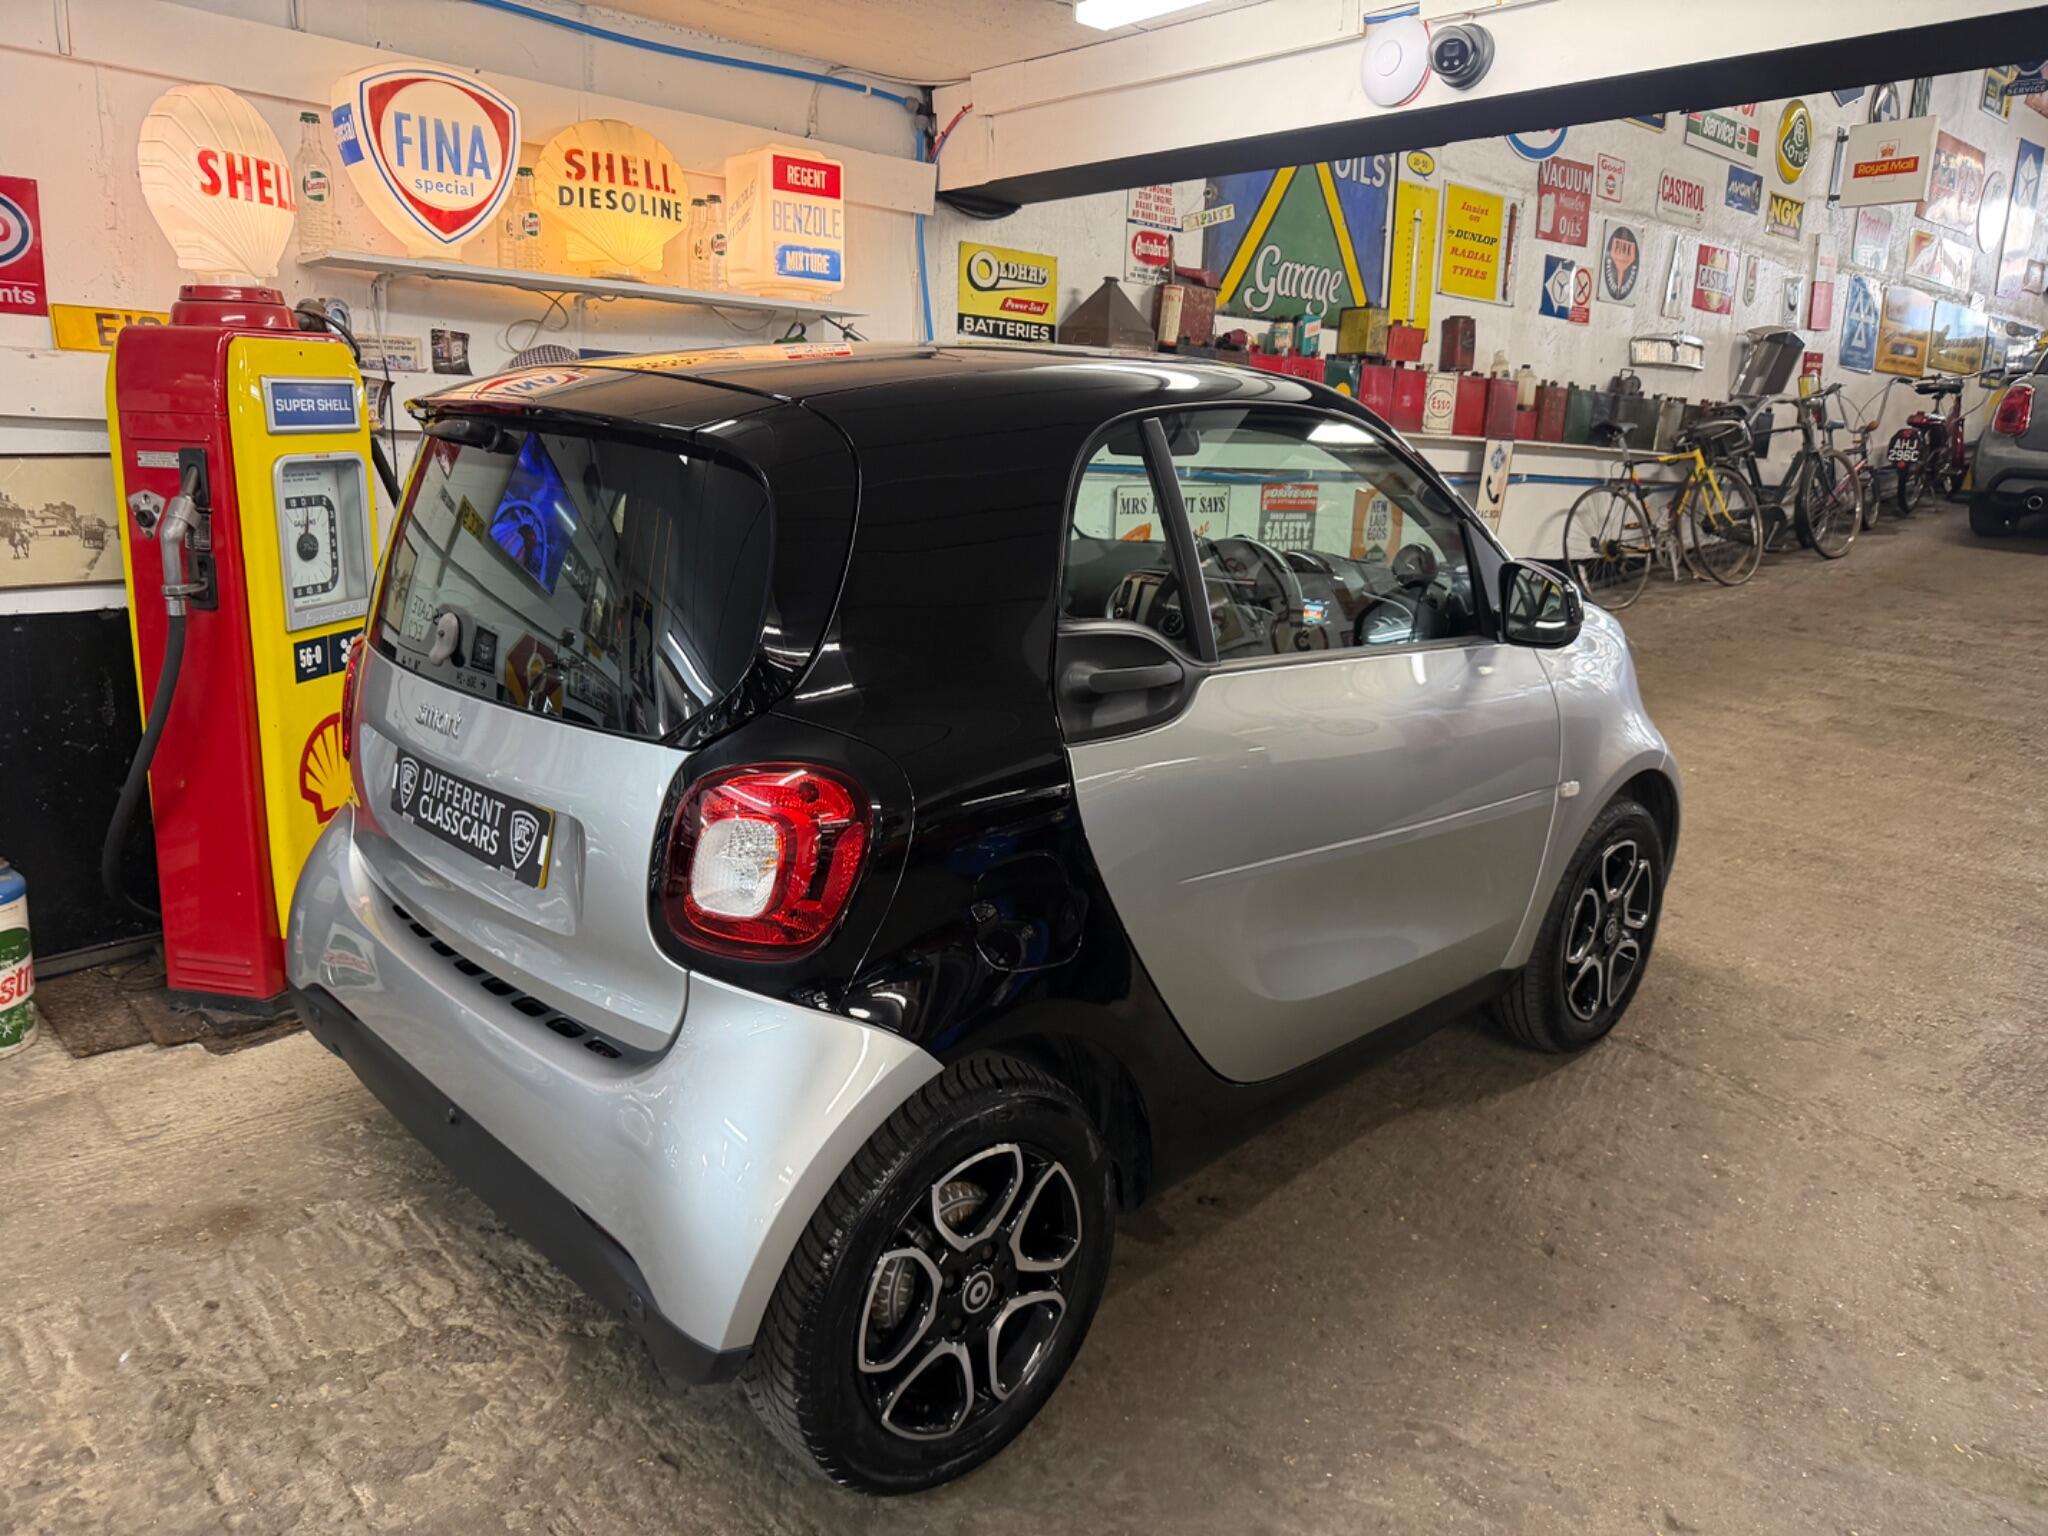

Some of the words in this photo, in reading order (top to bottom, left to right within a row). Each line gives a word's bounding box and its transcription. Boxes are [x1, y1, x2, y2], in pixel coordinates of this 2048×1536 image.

[1702, 115, 1735, 145] service
[394, 111, 492, 180] FINA
[1783, 139, 1809, 163] LOTUS
[564, 148, 677, 195] SHELL
[786, 164, 828, 190] REGENT
[1334, 153, 1386, 188] OILS
[1541, 159, 1593, 194] VACUUM
[1601, 159, 1623, 175] Good
[1858, 162, 1889, 175] Royal
[1890, 158, 1915, 171] Mail
[197, 149, 298, 212] SHELL
[415, 178, 475, 197] special
[558, 186, 683, 222] DIESOLINE
[1661, 174, 1705, 213] CASTROL
[773, 199, 842, 240] BENZOLE
[1461, 201, 1490, 216] Insist
[1771, 195, 1803, 228] NGK
[1455, 229, 1498, 246] DUNLOP
[1559, 215, 1582, 238] OILS
[785, 250, 831, 275] MIXTURE
[1450, 246, 1493, 264] RADIAL
[967, 250, 1049, 291] OLDHAM
[1244, 244, 1343, 319] Garage
[1452, 265, 1488, 281] TYRES
[1005, 298, 1029, 310] Power
[963, 316, 1050, 340] BATTERIES
[275, 398, 315, 412] SUPER
[316, 398, 352, 411] SHELL
[1894, 438, 1918, 450] AHJ
[1120, 497, 1148, 515] MRS
[1200, 496, 1226, 513] SAYS
[1371, 500, 1388, 513] NEW
[1264, 521, 1311, 541] SAFETY
[1369, 513, 1388, 527] LAID
[1368, 527, 1387, 541] EGGS
[415, 703, 463, 739] smart
[422, 767, 506, 829] DIFFERENT
[0, 963, 34, 1005] str
